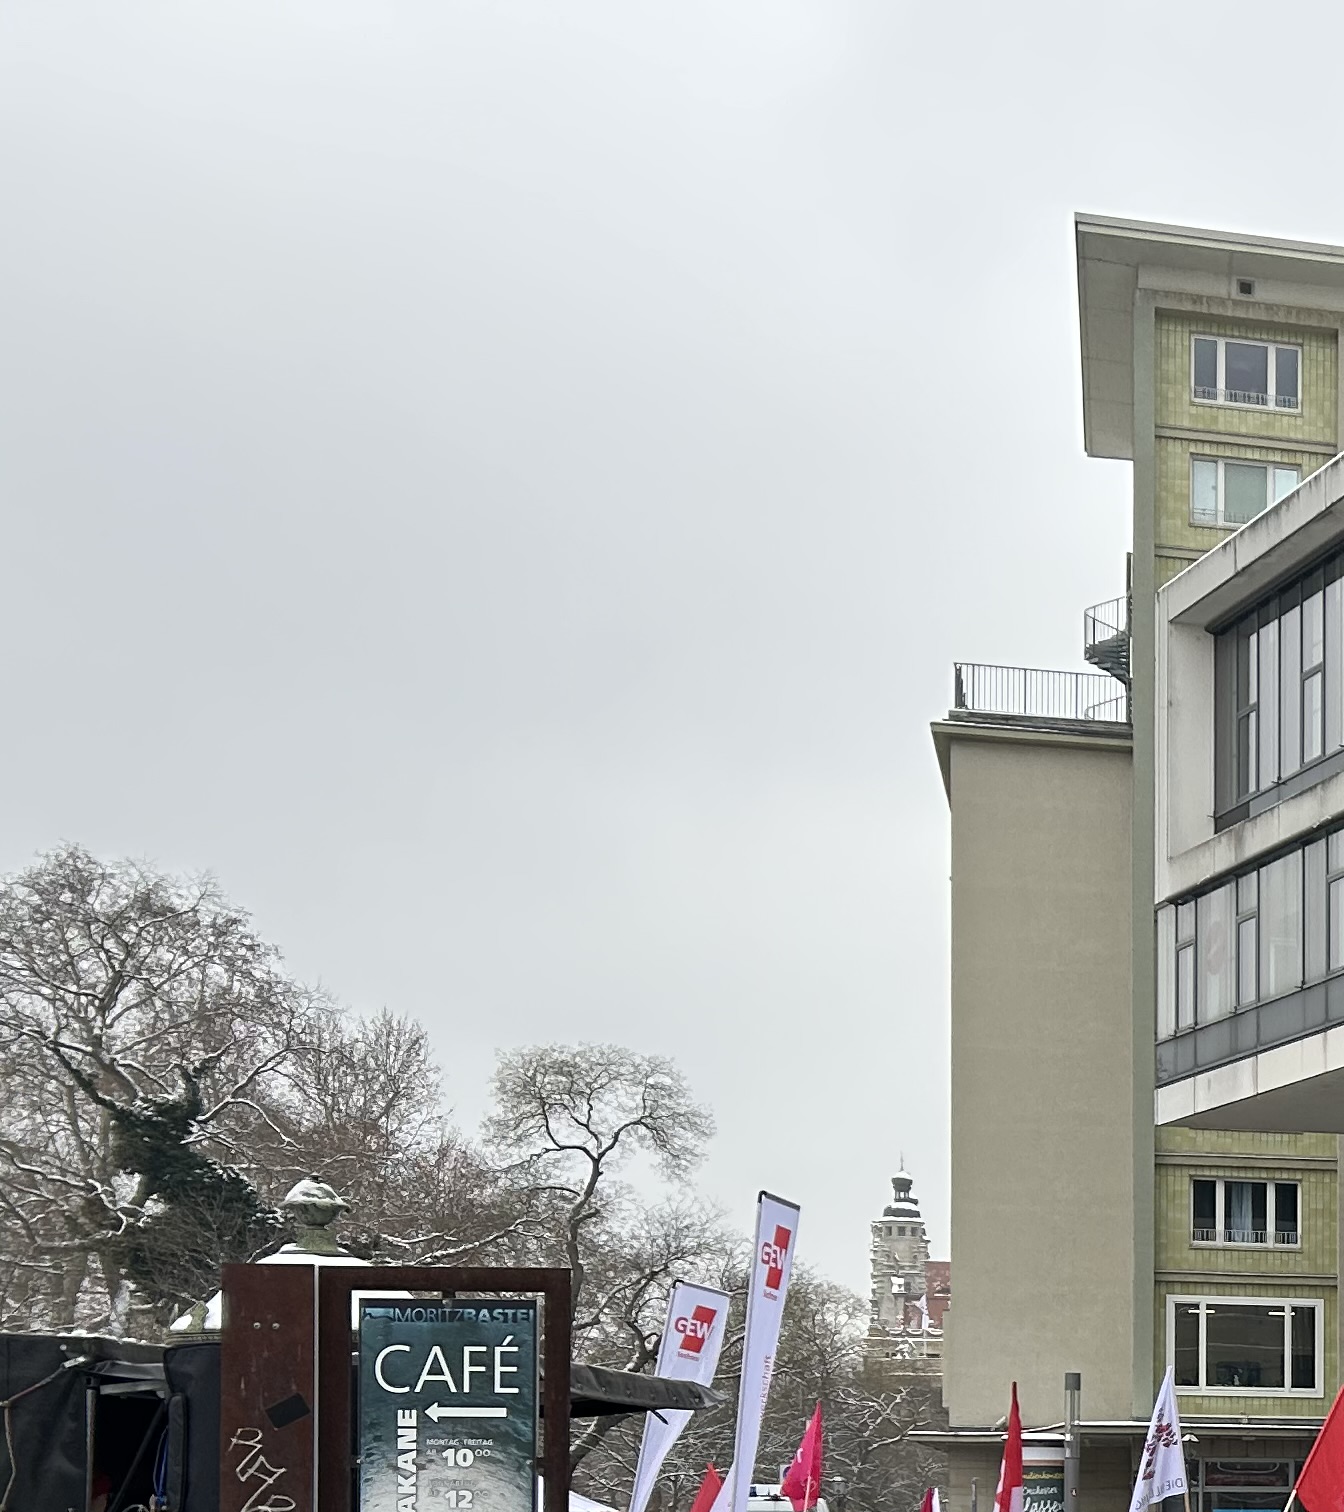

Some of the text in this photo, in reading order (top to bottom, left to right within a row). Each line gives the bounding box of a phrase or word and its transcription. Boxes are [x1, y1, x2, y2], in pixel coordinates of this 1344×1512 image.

[761, 1242, 787, 1270] GEW
[675, 1317, 714, 1340] GEW
[374, 1335, 519, 1394] CAFÉ
